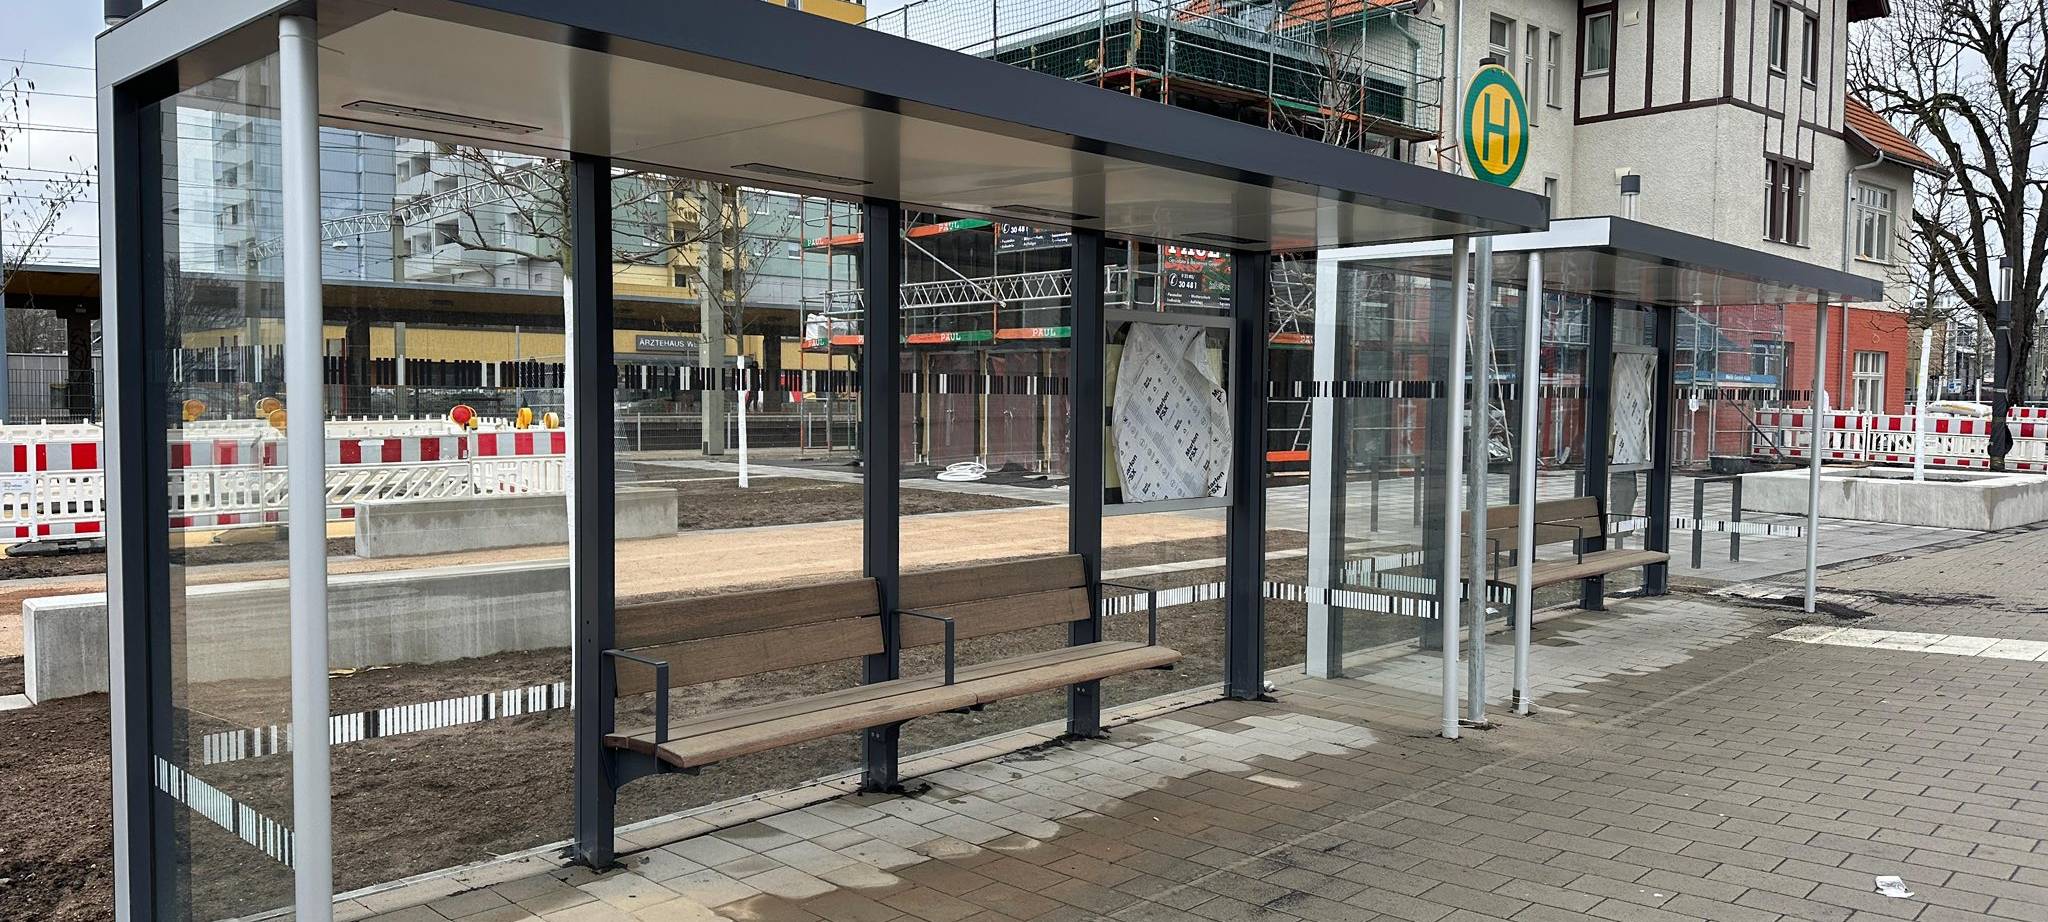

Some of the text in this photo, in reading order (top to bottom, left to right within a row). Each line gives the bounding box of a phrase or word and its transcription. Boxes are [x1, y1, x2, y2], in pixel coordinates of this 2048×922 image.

[1482, 93, 1511, 165] H
[938, 221, 960, 232] PAUL
[807, 237, 824, 247] PAUL
[940, 332, 961, 342] PAUL
[1032, 328, 1057, 337] PAUL
[639, 337, 685, 348] ÄRZTEHAUS
[1155, 391, 1169, 416] Marlon
[1159, 404, 1169, 421] FSX
[1185, 432, 1199, 456] Marlon
[1189, 446, 1198, 462] FSX
[1126, 454, 1138, 476] arlon
